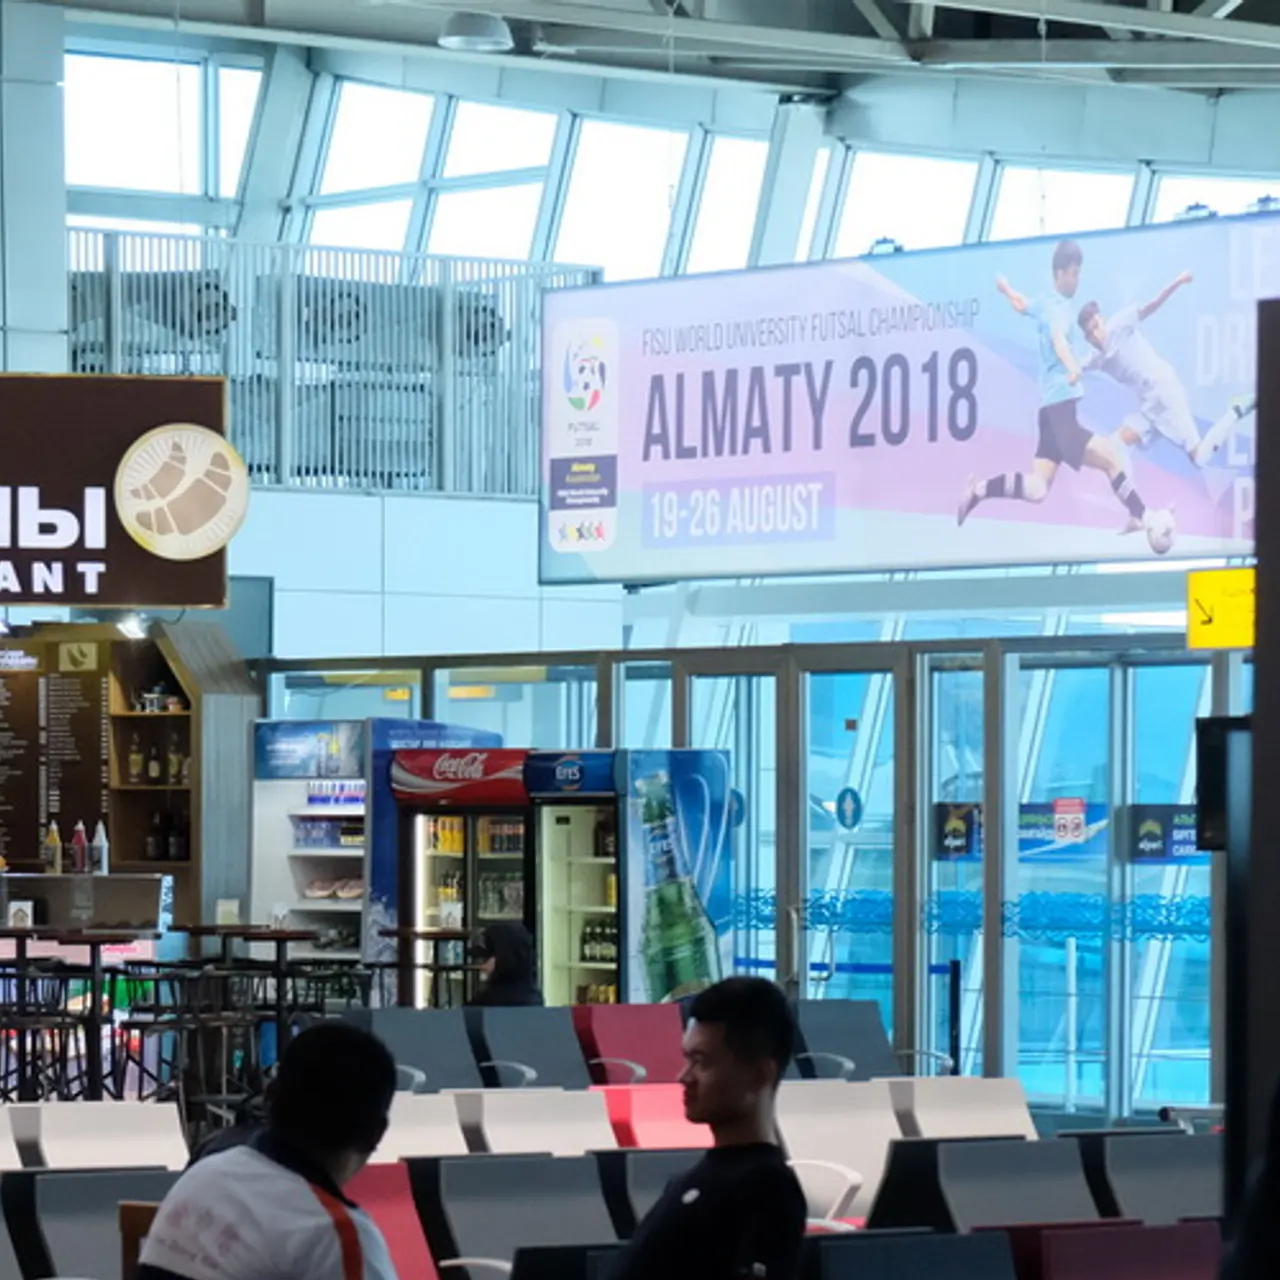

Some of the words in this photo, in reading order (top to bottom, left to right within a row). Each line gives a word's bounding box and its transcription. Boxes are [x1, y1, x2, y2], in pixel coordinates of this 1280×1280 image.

[642, 327, 671, 357] FISU
[674, 322, 723, 354] WORLD
[726, 314, 809, 349] UNIVERSITY
[811, 309, 866, 342] FUTSAL
[868, 298, 979, 337] CHAMPIONSHIP
[642, 359, 835, 463] ALMATY
[849, 346, 978, 449] 2018
[651, 488, 721, 539] 19-26
[727, 482, 824, 535] AUGUST
